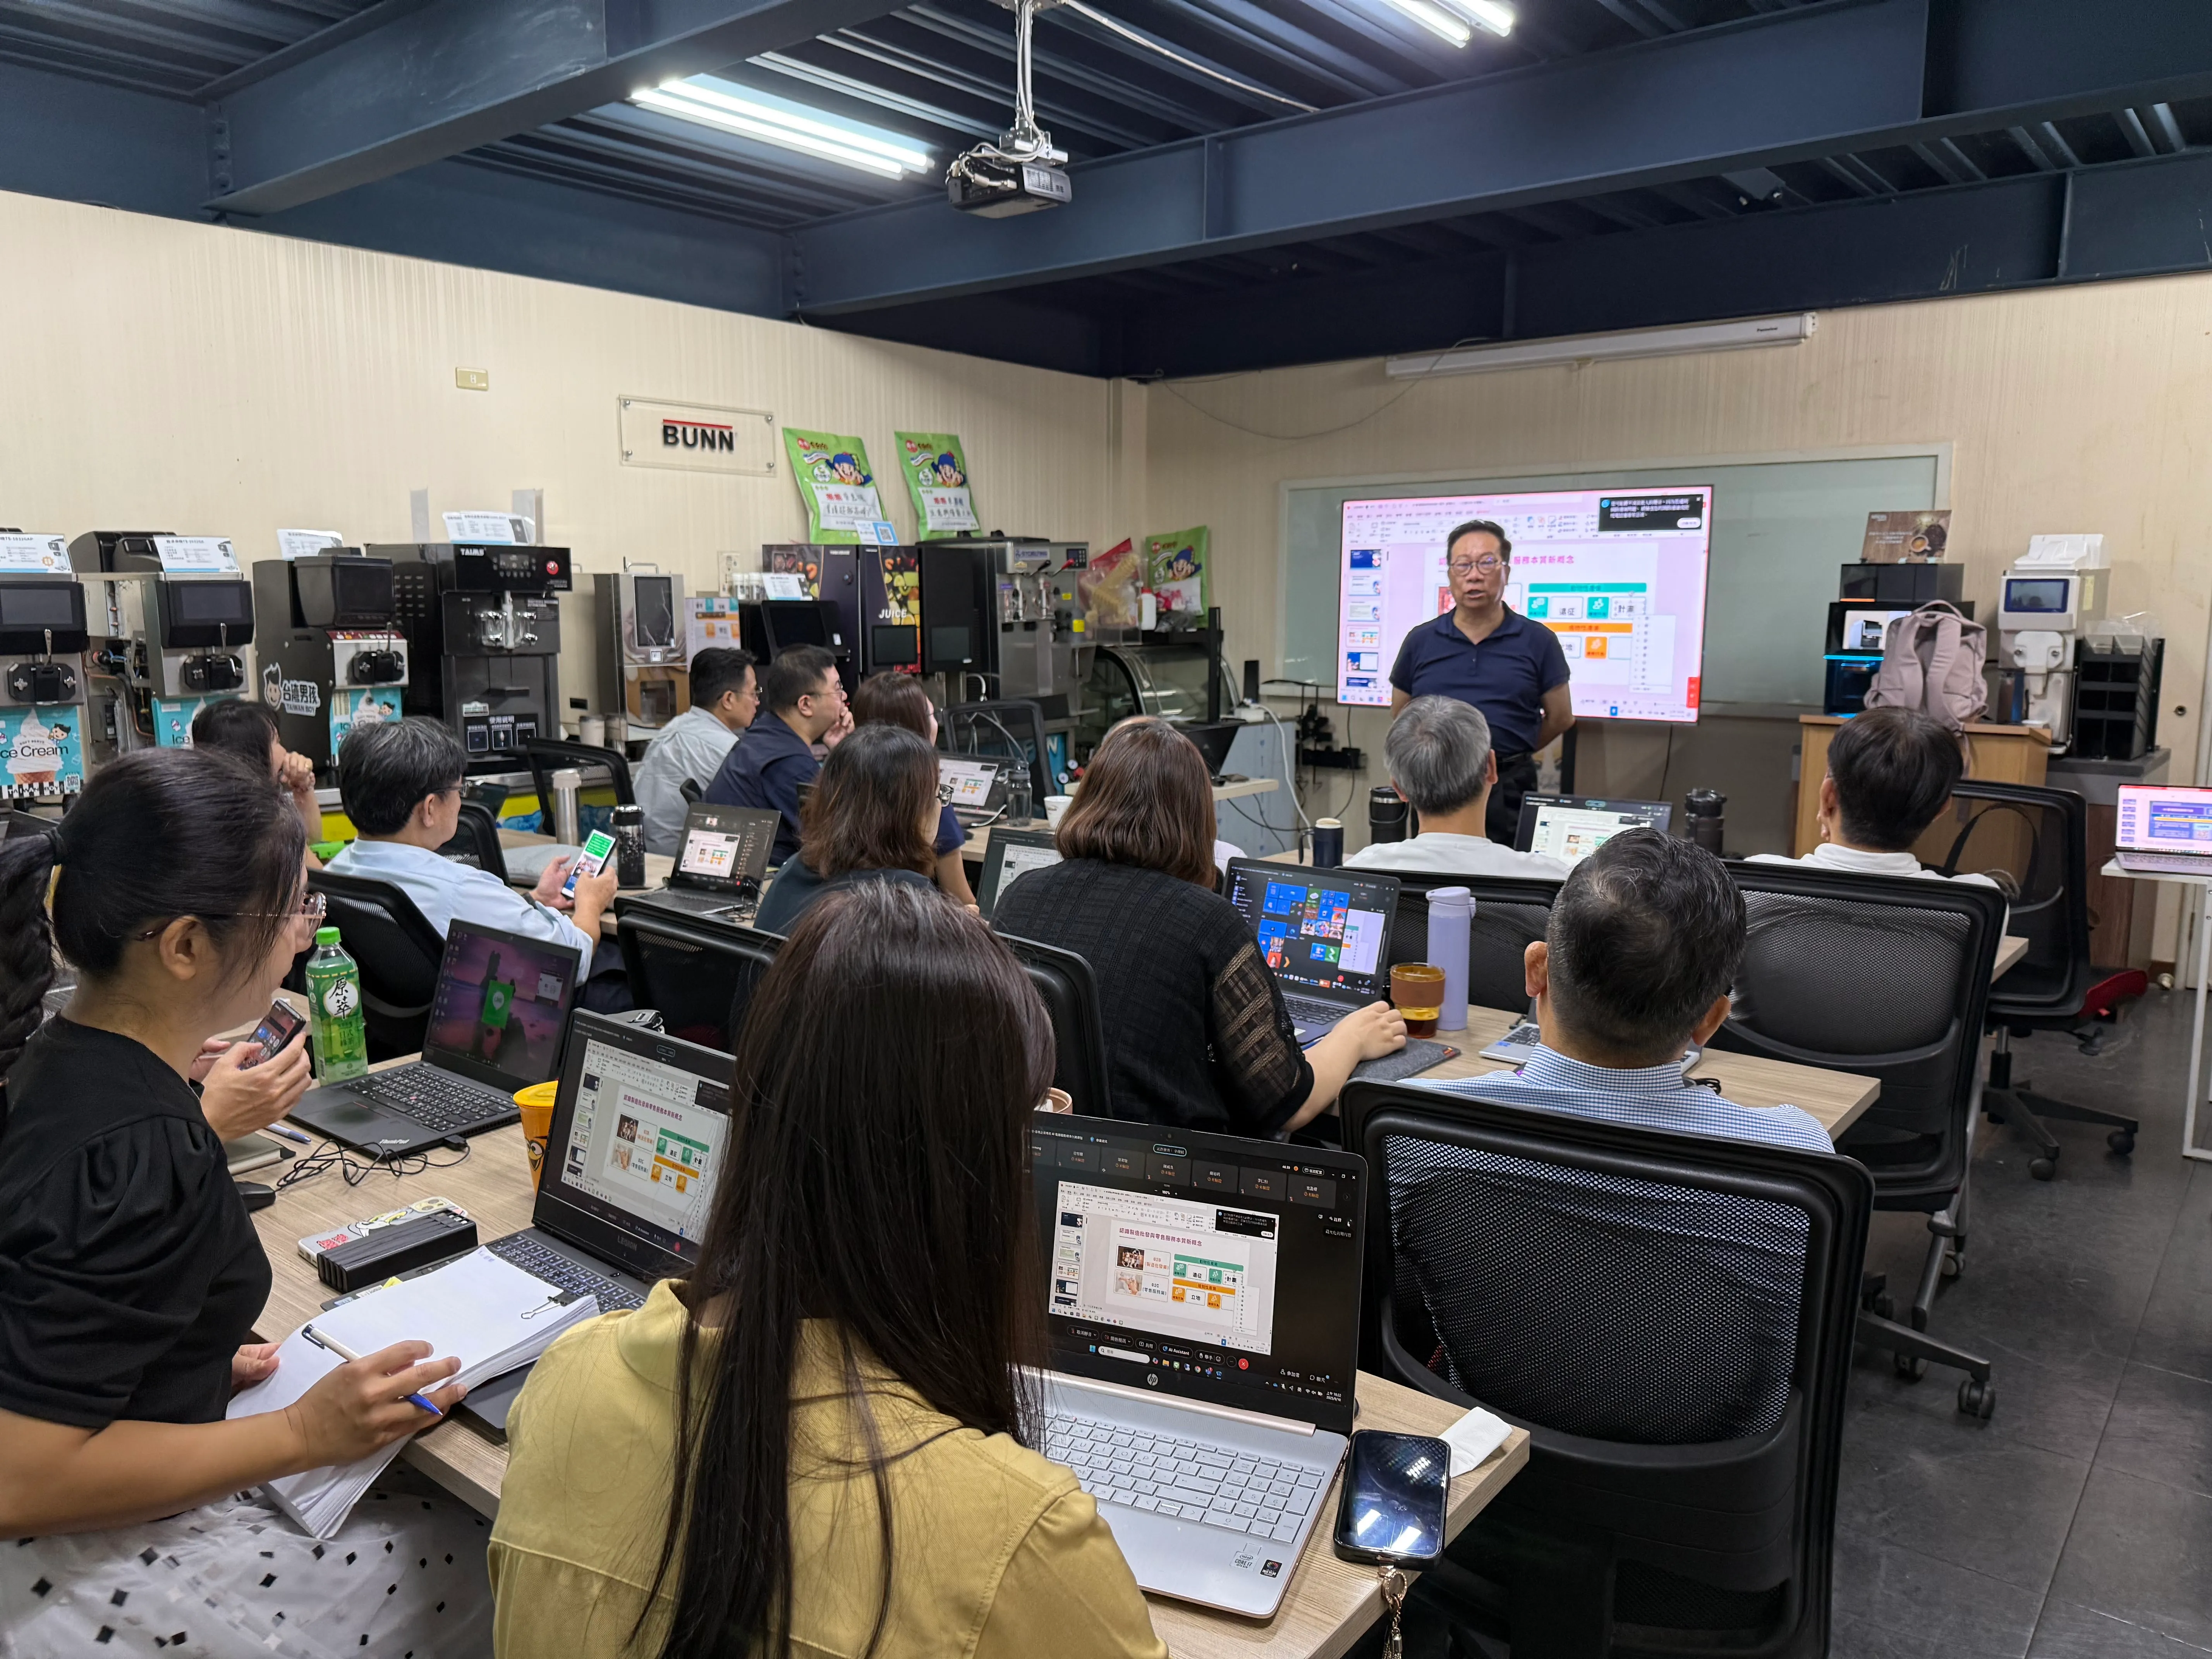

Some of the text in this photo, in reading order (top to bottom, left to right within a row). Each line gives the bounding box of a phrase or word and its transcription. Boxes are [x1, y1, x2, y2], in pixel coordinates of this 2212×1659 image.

[663, 424, 734, 452] BUNN
[878, 609, 907, 619] JUICE
[172, 734, 190, 744] Ice
[0, 745, 69, 759] ce Cream
[1147, 1374, 1158, 1386] hp
